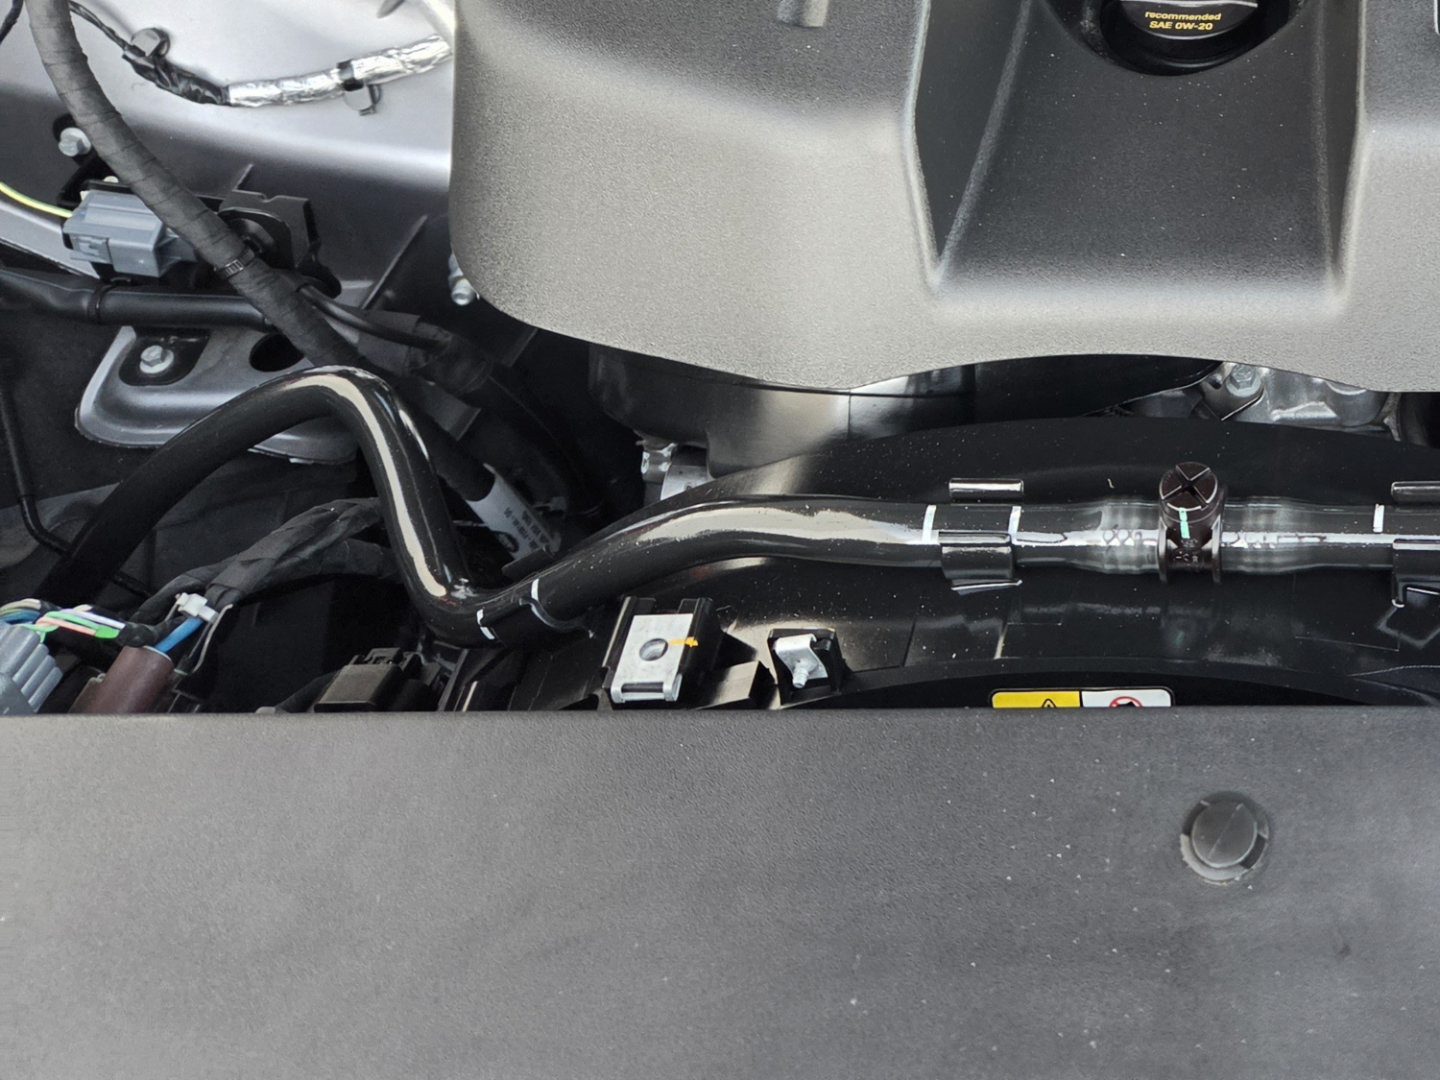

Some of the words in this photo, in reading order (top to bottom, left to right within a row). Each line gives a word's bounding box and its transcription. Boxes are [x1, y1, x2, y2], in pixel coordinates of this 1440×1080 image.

[1144, 11, 1222, 21] recommended
[1149, 21, 1173, 29] SAE
[1175, 22, 1214, 30] 0W-20
